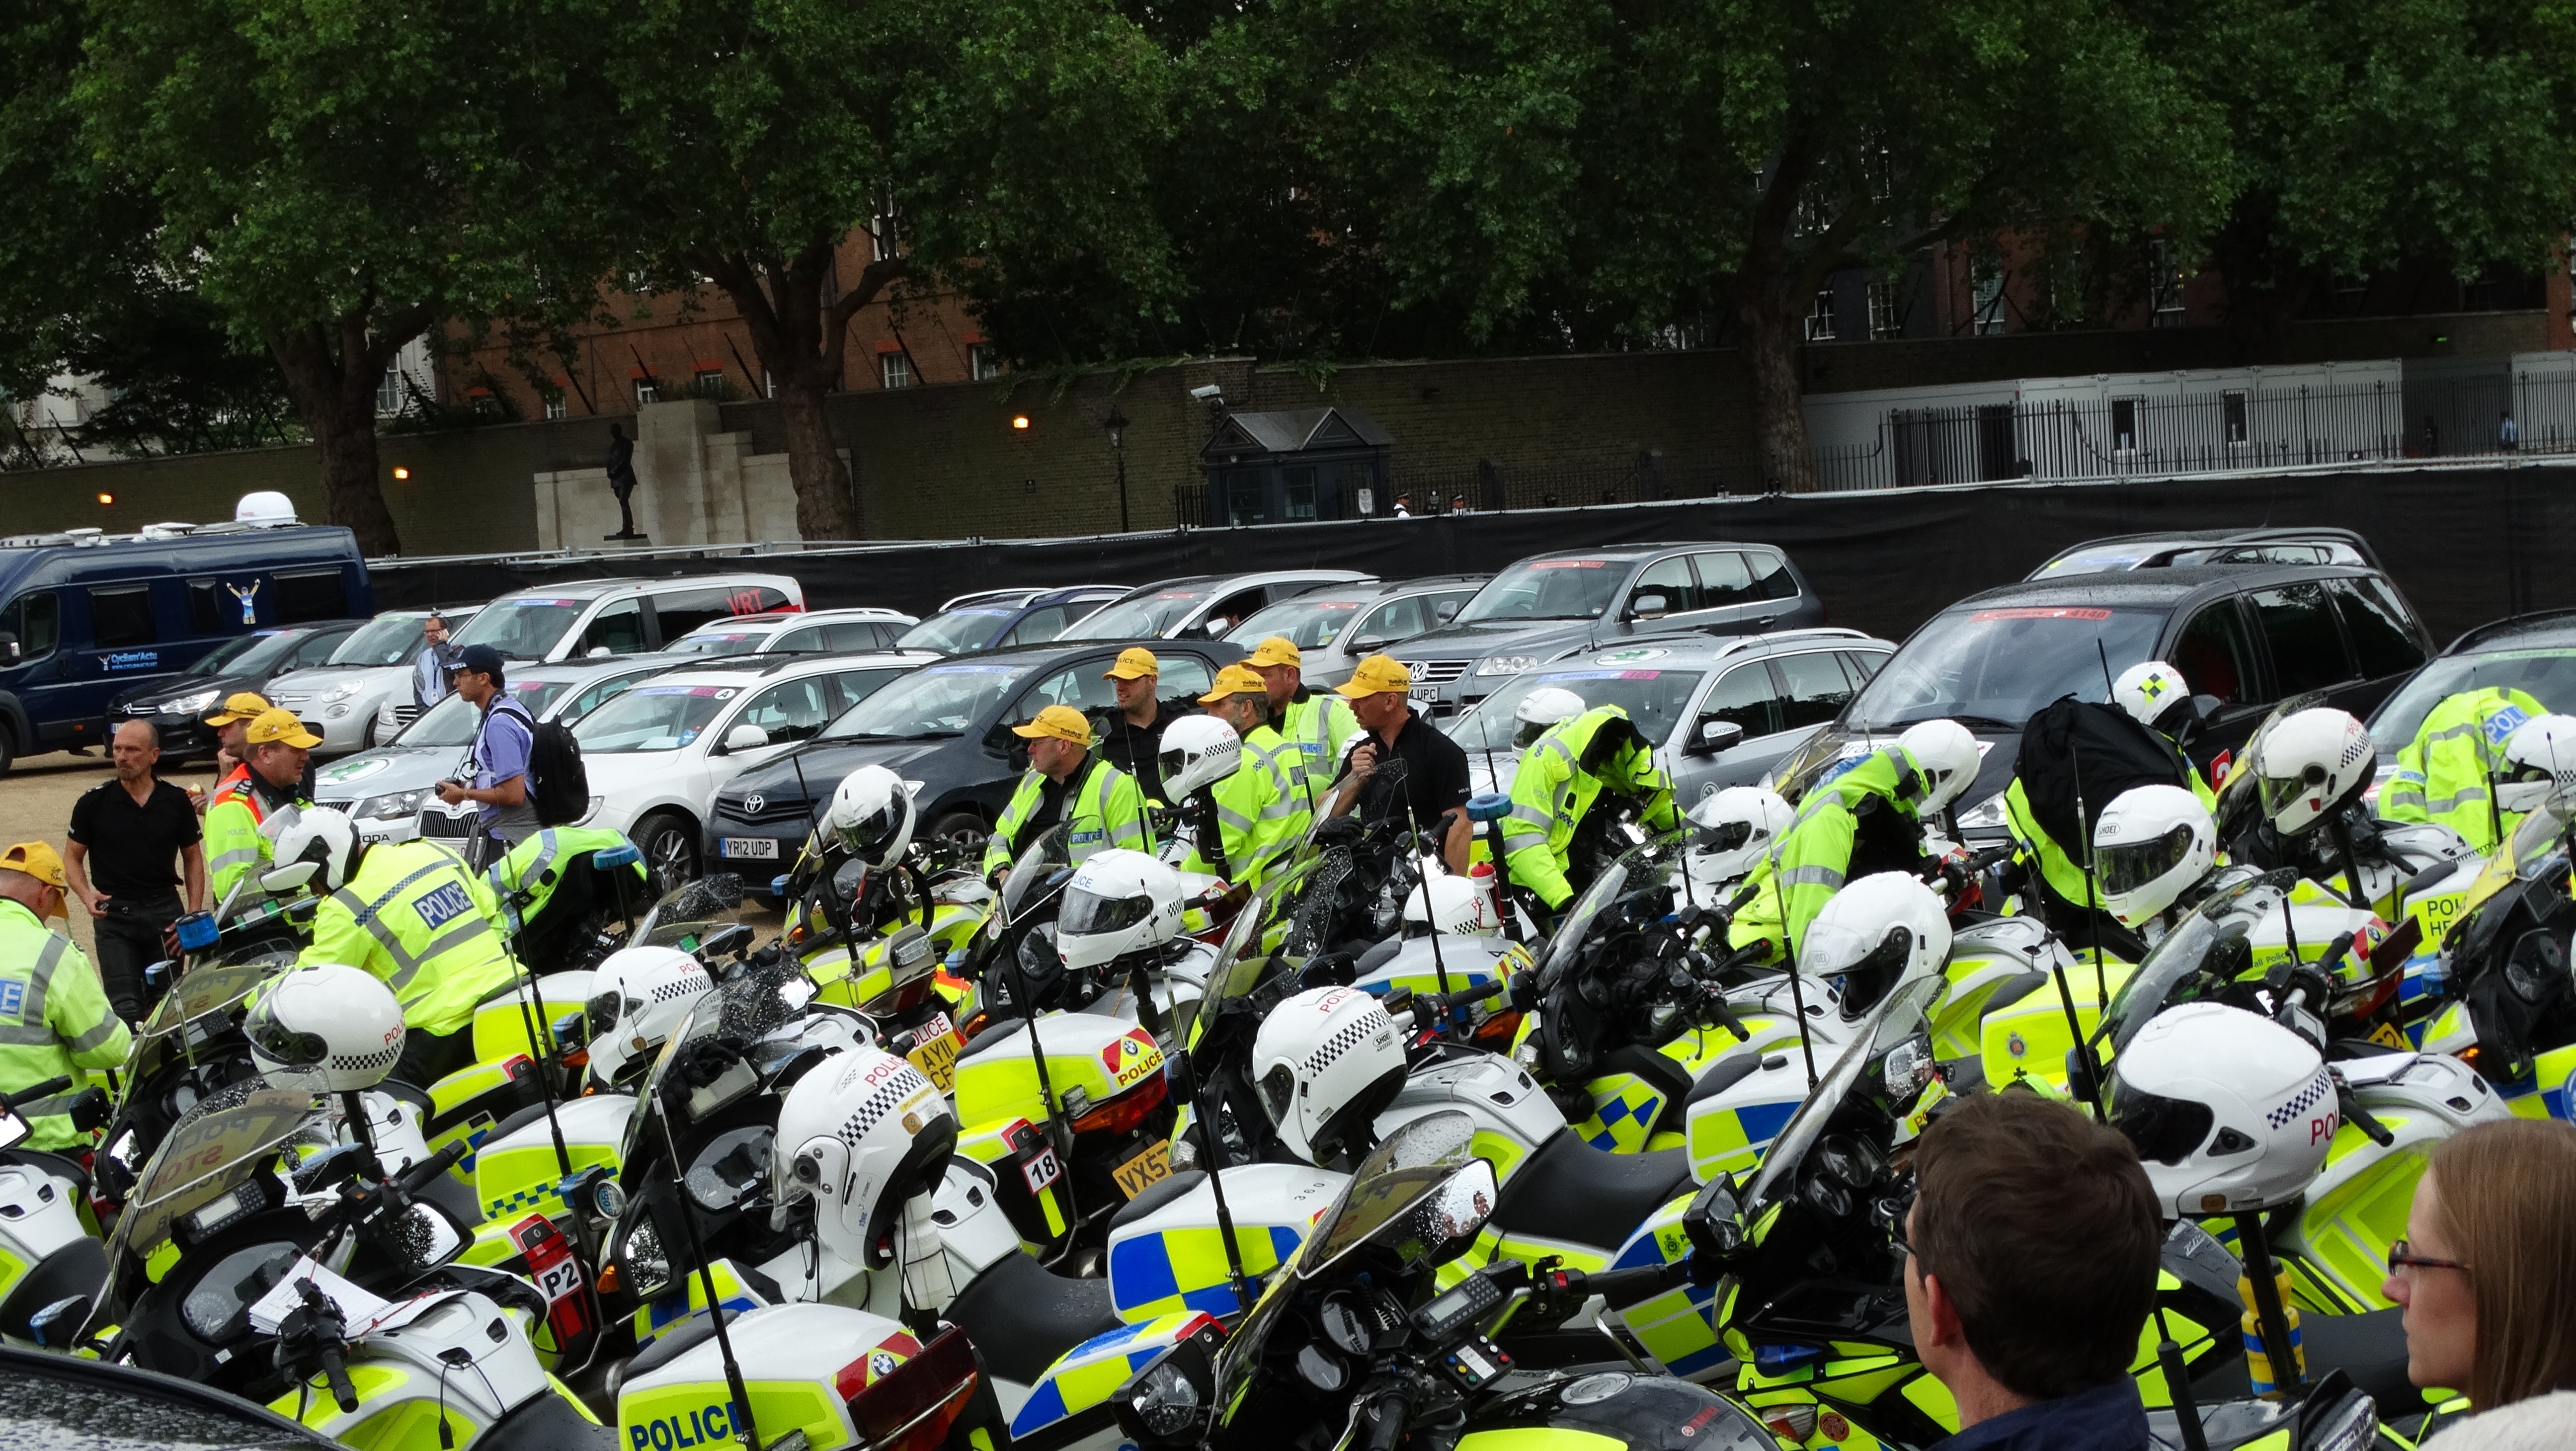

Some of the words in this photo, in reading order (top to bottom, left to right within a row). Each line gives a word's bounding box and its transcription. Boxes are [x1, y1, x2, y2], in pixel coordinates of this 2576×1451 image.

[726, 588, 763, 616] VRT
[1417, 689, 1436, 700] UPC
[2099, 825, 2117, 835] SHOEI
[362, 834, 391, 843] ODA
[1072, 832, 1101, 843] POLICE
[727, 840, 749, 855] YR12
[751, 841, 772, 856] UDP
[416, 883, 471, 927] POLICE
[2254, 959, 2263, 968] all
[1375, 1033, 1390, 1046] SHOEI
[1118, 1050, 1163, 1087] POLICE
[1031, 1154, 1056, 1184] 18
[543, 1263, 579, 1298] P2
